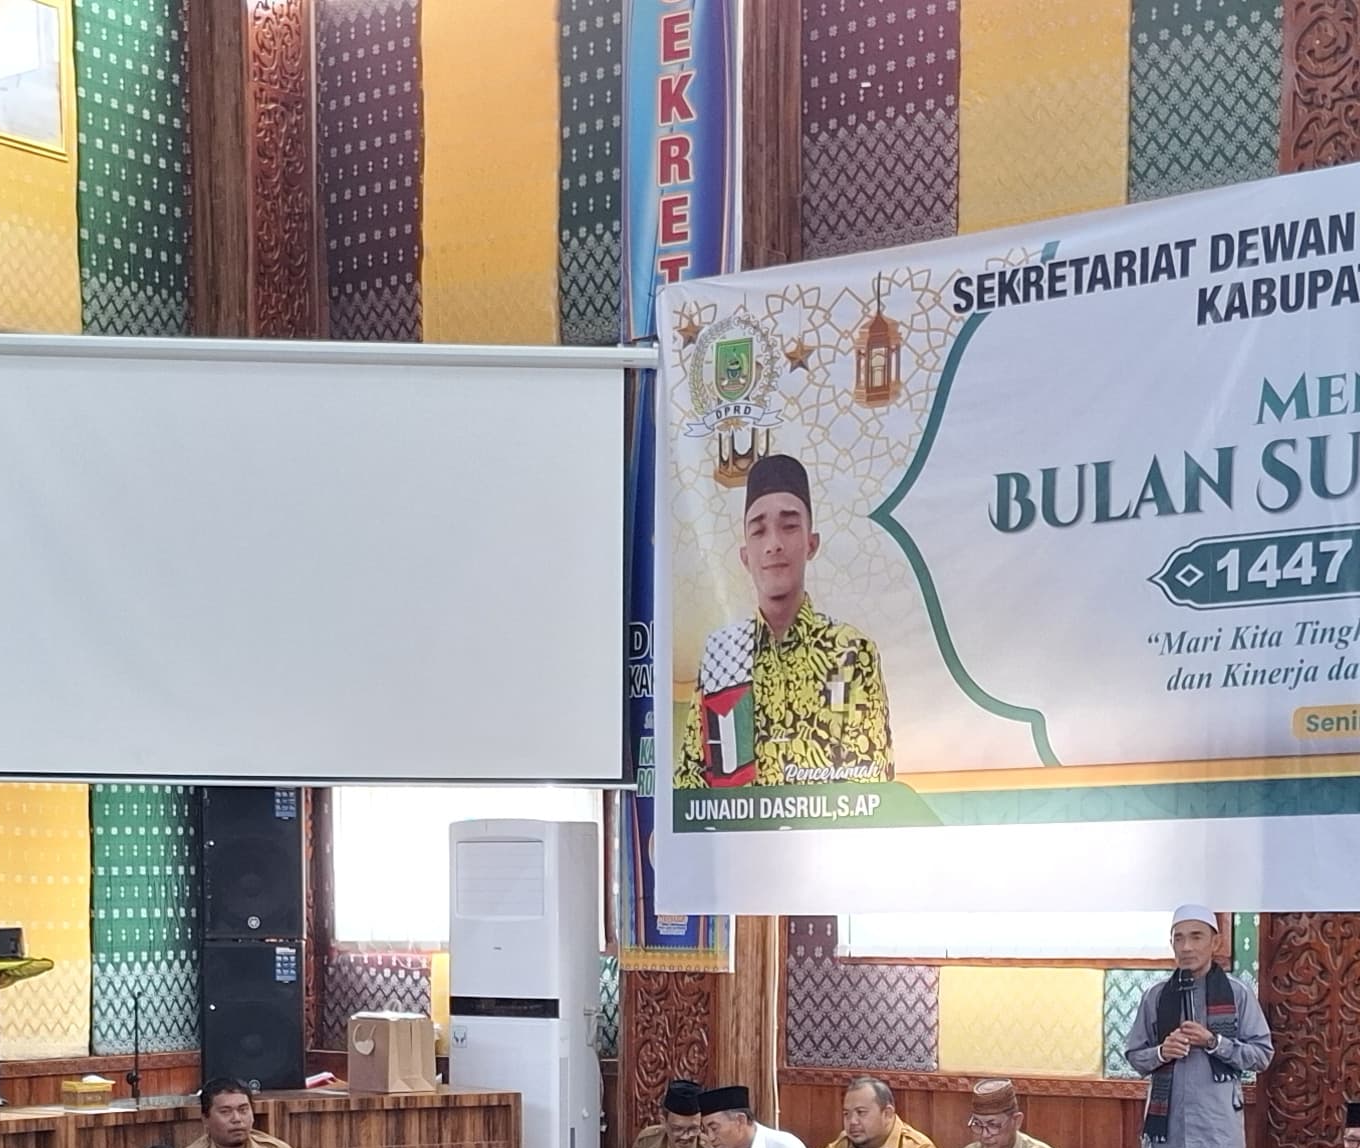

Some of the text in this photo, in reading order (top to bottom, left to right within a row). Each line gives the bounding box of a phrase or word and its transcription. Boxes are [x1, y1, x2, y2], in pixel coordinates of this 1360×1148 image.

[658, 0, 696, 285] EKRET
[952, 238, 1198, 315] SEKRETARIAT
[1209, 211, 1355, 274] DEWAN
[715, 405, 752, 419] DPRD
[988, 446, 1236, 533] BULAN
[1215, 539, 1352, 592] 1447
[1231, 623, 1284, 652] Kita
[1166, 666, 1213, 692] dan
[1221, 660, 1320, 691] Kinerja
[784, 763, 881, 782] Penceramah
[685, 798, 754, 821] JUNAIDI
